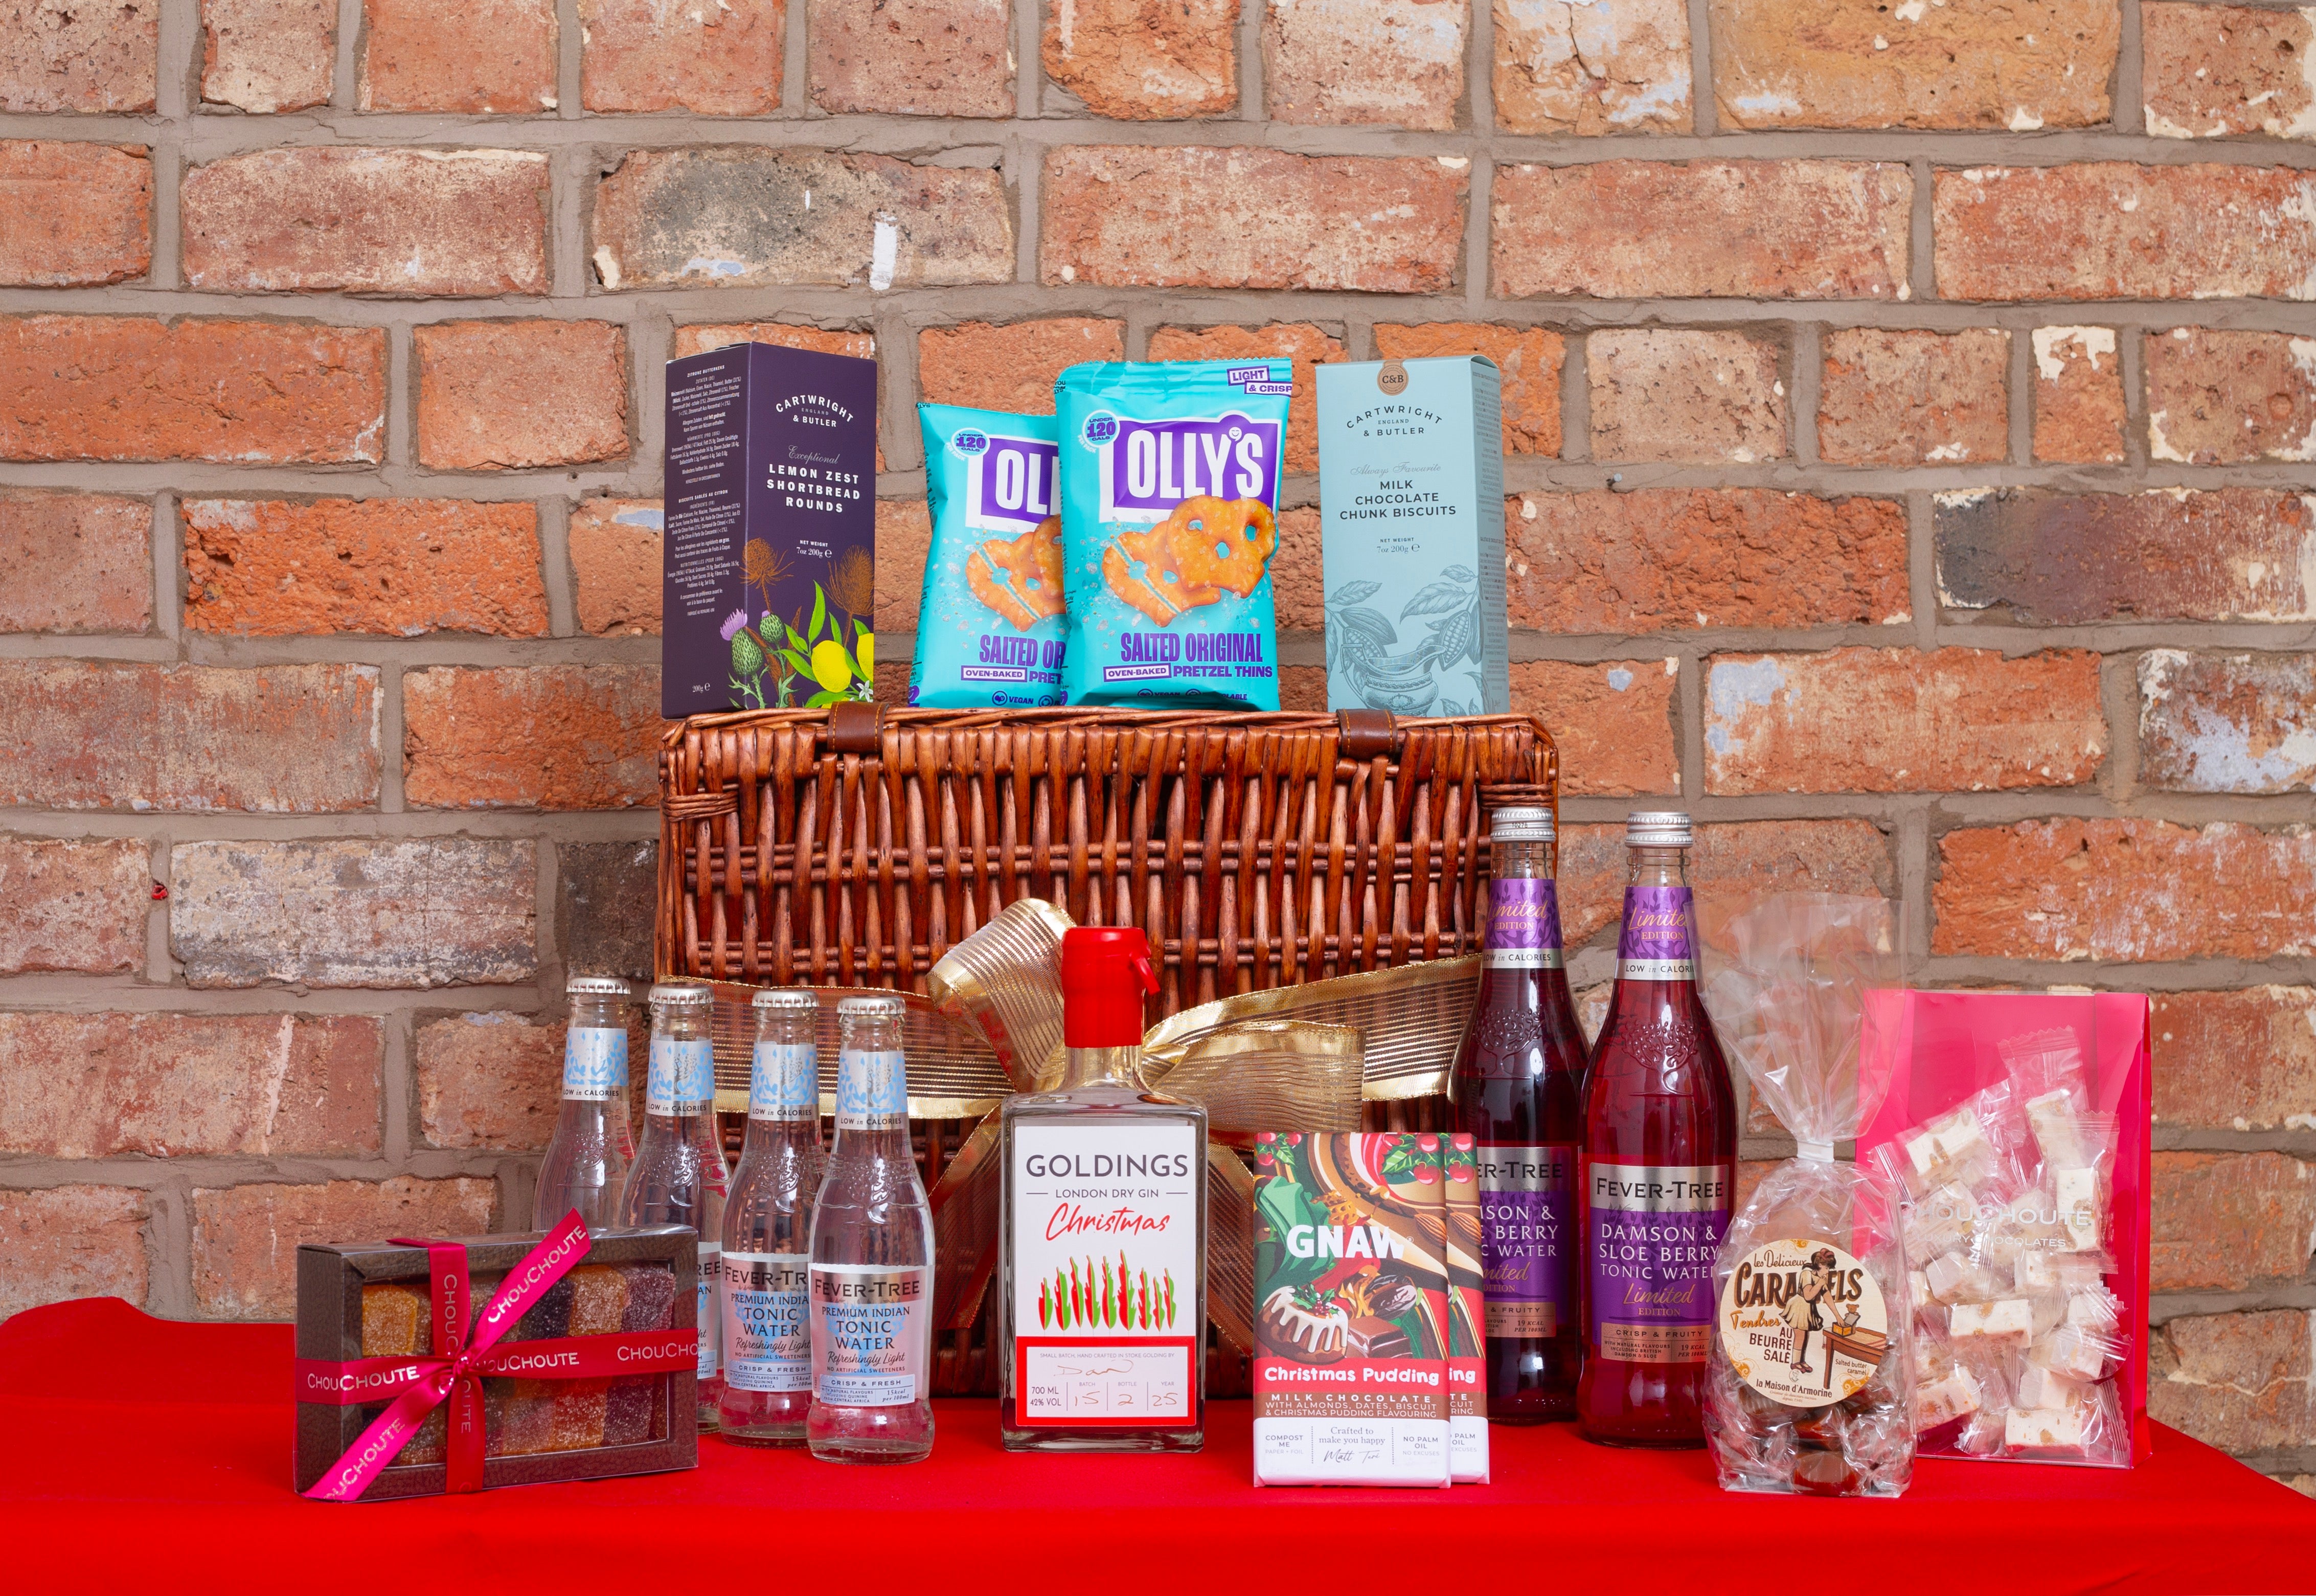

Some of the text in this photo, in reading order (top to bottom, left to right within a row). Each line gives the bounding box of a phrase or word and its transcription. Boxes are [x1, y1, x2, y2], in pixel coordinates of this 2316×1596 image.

[1233, 370, 1264, 381] LIGHT
[1382, 375, 1403, 383] C&B
[776, 395, 853, 422] CARTWRIGHT
[803, 416, 836, 427] BUTLER
[1347, 405, 1442, 428] CARTWRIGHT
[1087, 421, 1116, 438] 120
[1377, 427, 1425, 436] BUTLER
[788, 445, 840, 464] Exceptional
[1083, 443, 1096, 453] PACK
[769, 464, 858, 484] LEMON ZEST
[1350, 462, 1441, 478] Always Favourite
[767, 479, 860, 499] SHORTBREAD
[1380, 480, 1413, 490] MILK
[786, 497, 843, 513] ROUNDS
[1355, 493, 1439, 505] CHOCOLATE
[1340, 506, 1456, 520] CHUNK BISCUITS
[808, 549, 823, 558] 200g
[1391, 545, 1409, 554] 200g
[1121, 632, 1263, 662] SALTED ORIGINAL
[1108, 666, 1273, 677] OVEN-BAKED PRETZEL THINS
[1487, 899, 1548, 921] Limited
[1494, 921, 1534, 930] EDITION
[1026, 1154, 1188, 1177] GOLDINGS
[1056, 1189, 1159, 1198] LONDON DRY GIN
[1596, 1177, 1723, 1199] FEVER-TREE
[1900, 1201, 2092, 1226] CHOUCHOUTE
[1046, 1202, 1170, 1241] Christmas
[1601, 1224, 1717, 1241] DAMSON &
[1287, 1225, 1405, 1259] GNAW
[1917, 1234, 2066, 1248] LUXURY CHOCOLATES
[1599, 1243, 1719, 1262] SLOE BERRY
[1754, 1249, 1807, 1268] les Délicieux
[488, 1224, 587, 1324] CHOUCHOUTE
[1600, 1263, 1653, 1279] TONIC
[815, 1279, 920, 1297] FEVER-TREE
[1624, 1284, 1696, 1305] Limited
[822, 1307, 910, 1317] PREMIUM INDIAN
[1638, 1307, 1681, 1316] EDITION
[836, 1320, 891, 1334] TONIC
[1729, 1310, 1781, 1330] Tendres
[1780, 1327, 1792, 1338] AU
[834, 1337, 895, 1350] WATER
[1750, 1333, 1792, 1351] BEURRE
[828, 1351, 905, 1366] Refreshingly Light
[1764, 1349, 1790, 1364] SALÉ
[1835, 1359, 1867, 1369] Salted butter
[307, 1366, 420, 1391] CHOUCHOUTE
[1264, 1366, 1356, 1382] Christmas
[1363, 1367, 1439, 1386] Pudding
[1032, 1386, 1045, 1395] 700
[1756, 1378, 1763, 1387] la
[1764, 1379, 1790, 1392] Maison
[1791, 1383, 1832, 1398] d'Armorine
[1075, 1391, 1100, 1406] 15
[1118, 1394, 1134, 1406] 2
[1152, 1393, 1178, 1406] 25
[1326, 1394, 1431, 1403] CHOCOLATE
[1356, 1402, 1391, 1410] DATES,
[1361, 1437, 1386, 1445] happy
